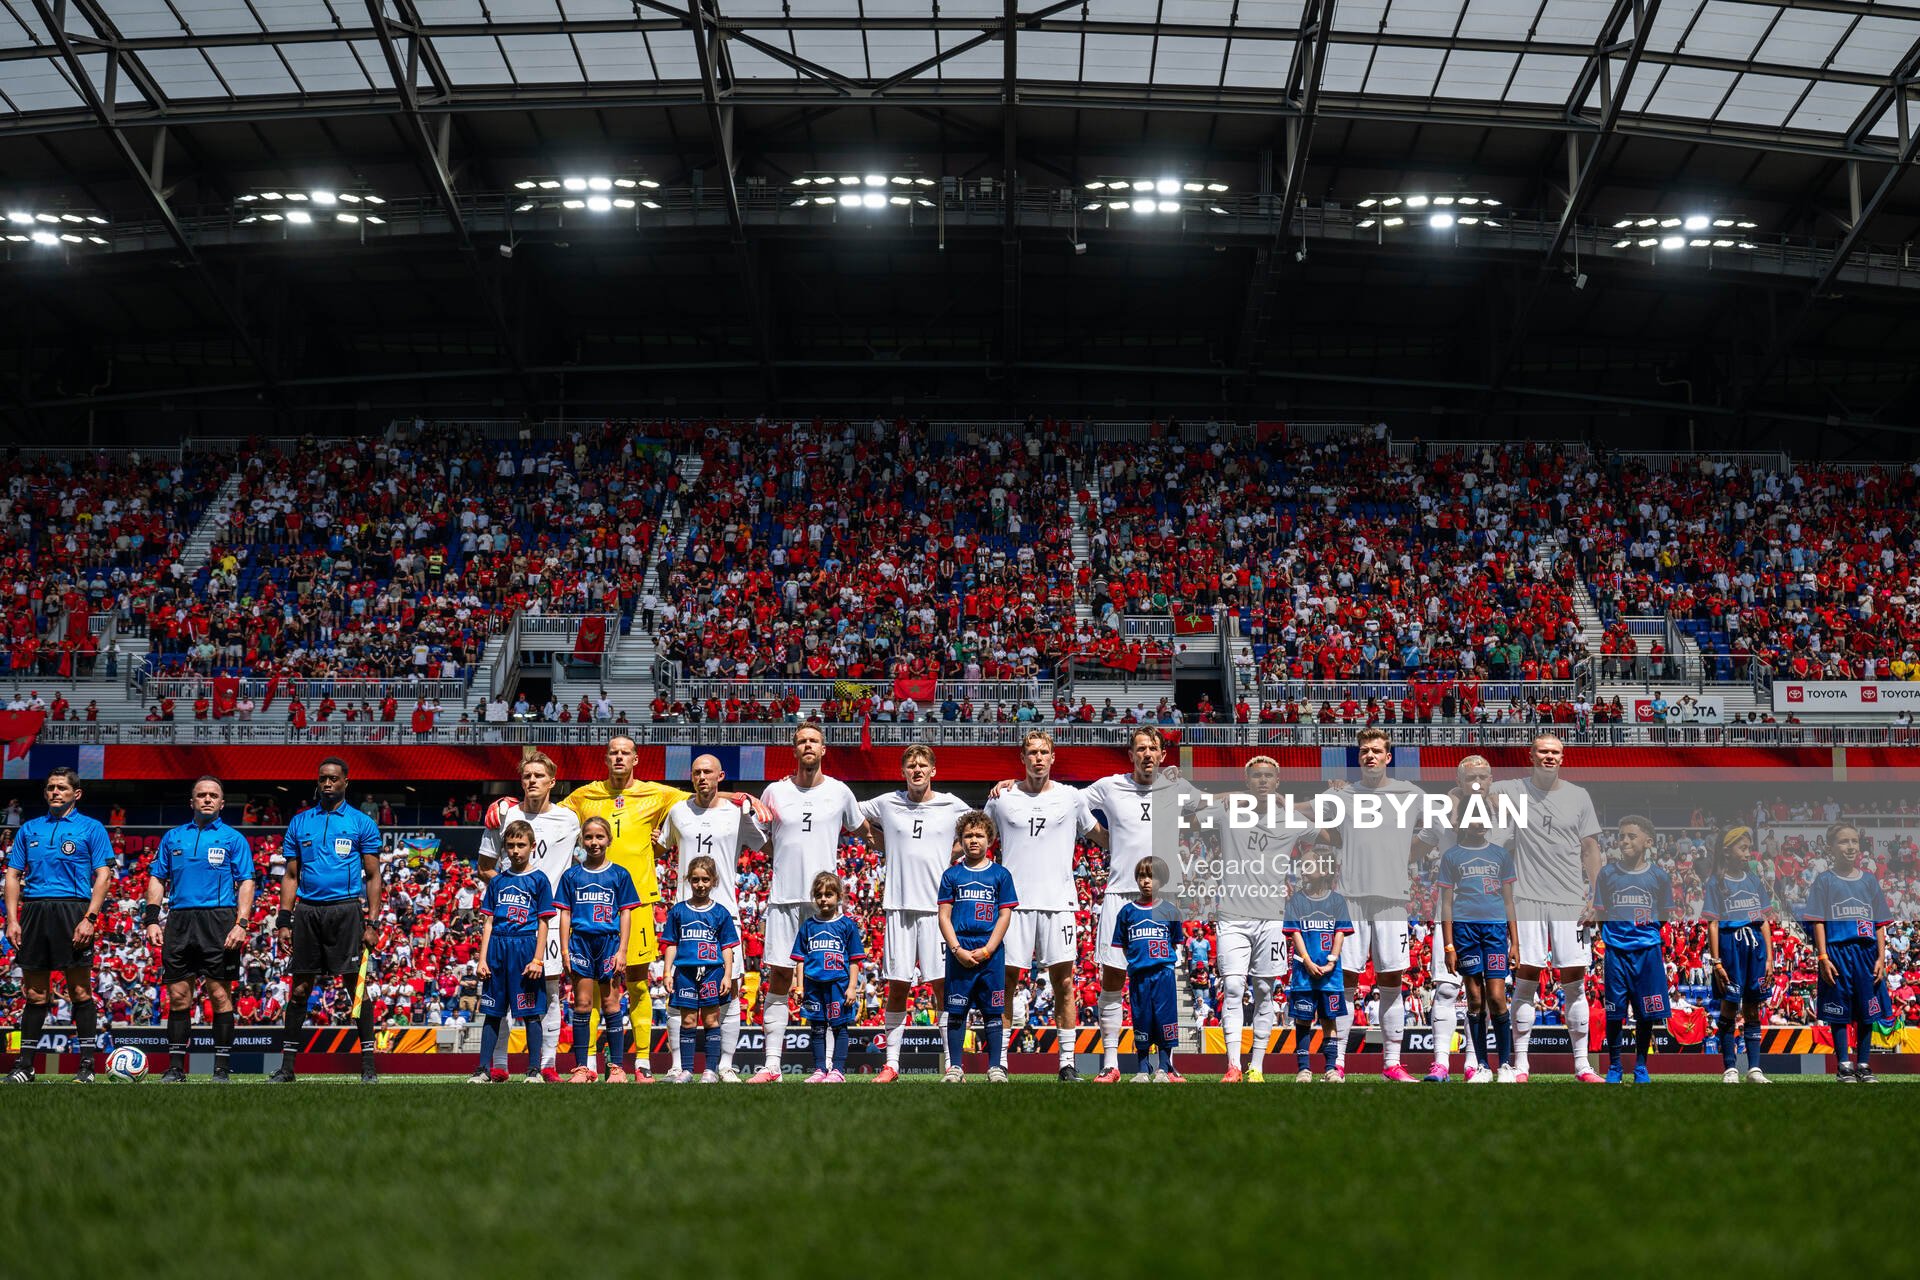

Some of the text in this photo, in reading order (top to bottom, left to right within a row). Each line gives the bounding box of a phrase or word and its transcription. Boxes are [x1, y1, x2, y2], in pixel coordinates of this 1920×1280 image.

[1807, 690, 1847, 699] TOYOTA
[1881, 690, 1920, 699] TOYOTA
[1666, 707, 1717, 717] TOOTA
[1141, 803, 1151, 821] 8
[615, 819, 620, 838] 1
[802, 812, 812, 832] 3
[912, 820, 923, 839] 5
[1028, 817, 1046, 837] 17
[1543, 815, 1552, 835] 9
[696, 833, 713, 854] 14
[1248, 831, 1268, 851] 20
[577, 890, 611, 902] LOWE'S
[959, 889, 993, 900] LOWE'S
[1616, 893, 1650, 906] LOWE'S
[593, 904, 613, 923] 26
[976, 902, 995, 922] 26
[1836, 906, 1869, 917] LOWE'S
[1131, 927, 1165, 938] LOWE'S
[1303, 919, 1335, 930] LOWE'S
[640, 928, 647, 947] 1
[681, 928, 714, 940] LOWE'S
[1062, 926, 1074, 945] 17
[1320, 933, 1335, 951] 2
[1400, 933, 1408, 953] 7
[698, 942, 718, 961] 26
[1149, 941, 1169, 959] 26
[824, 952, 845, 971] 26
[1488, 954, 1506, 971] 26
[700, 981, 718, 999] 26
[1644, 994, 1664, 1013] 26
[233, 1037, 272, 1046] AIRLINES
[785, 1034, 811, 1049] 26
